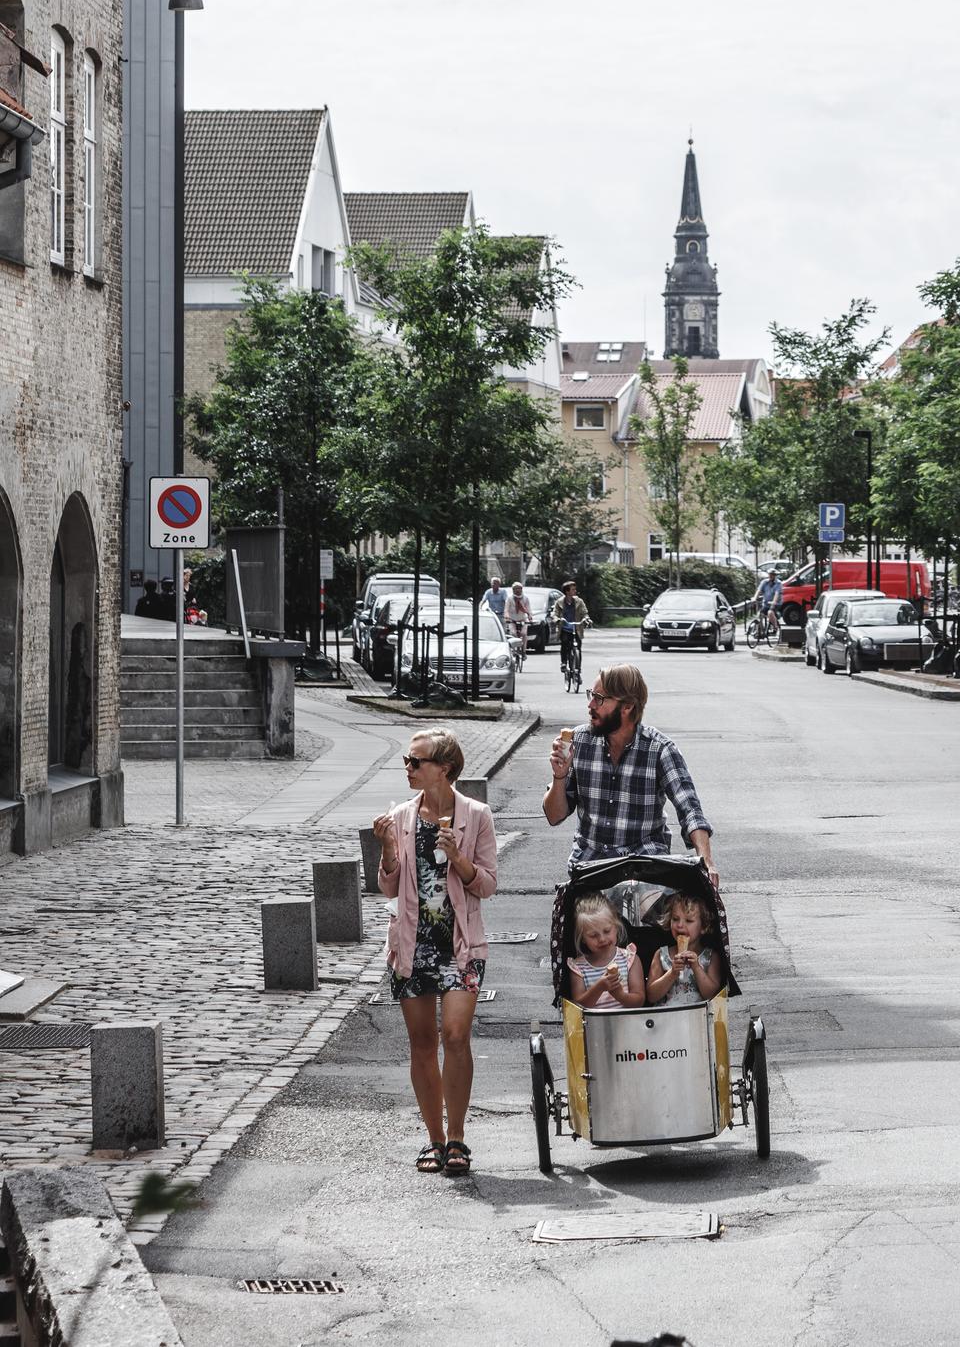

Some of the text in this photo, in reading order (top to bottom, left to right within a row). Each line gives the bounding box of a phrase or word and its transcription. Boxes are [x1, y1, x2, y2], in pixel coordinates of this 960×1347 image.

[825, 506, 840, 526] P
[163, 533, 195, 543] Zone
[615, 1048, 688, 1062] nihola.com
